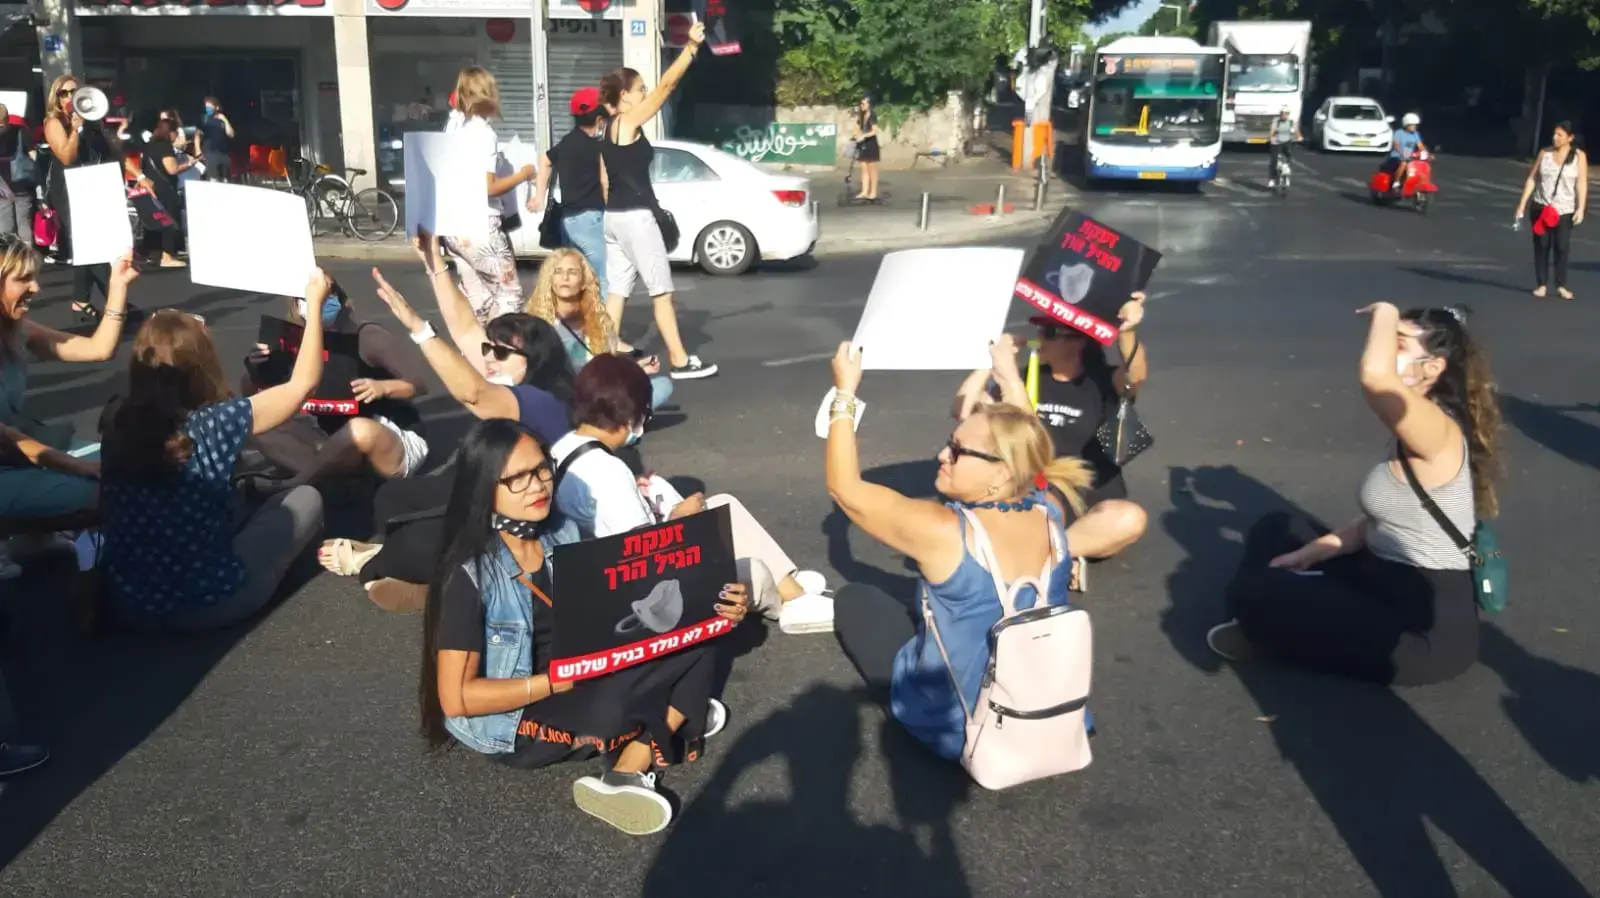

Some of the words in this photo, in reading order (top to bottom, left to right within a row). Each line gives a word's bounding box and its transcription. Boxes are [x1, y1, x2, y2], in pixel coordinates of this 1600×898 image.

[632, 22, 644, 33] 21
[623, 524, 684, 557] זעקת
[654, 545, 701, 575] הגיל
[603, 560, 647, 590] הרך
[682, 627, 704, 644] לא
[705, 619, 730, 635] ילד
[648, 635, 680, 655] נולד
[611, 646, 645, 667] בגיל
[556, 657, 608, 679] שלוש
